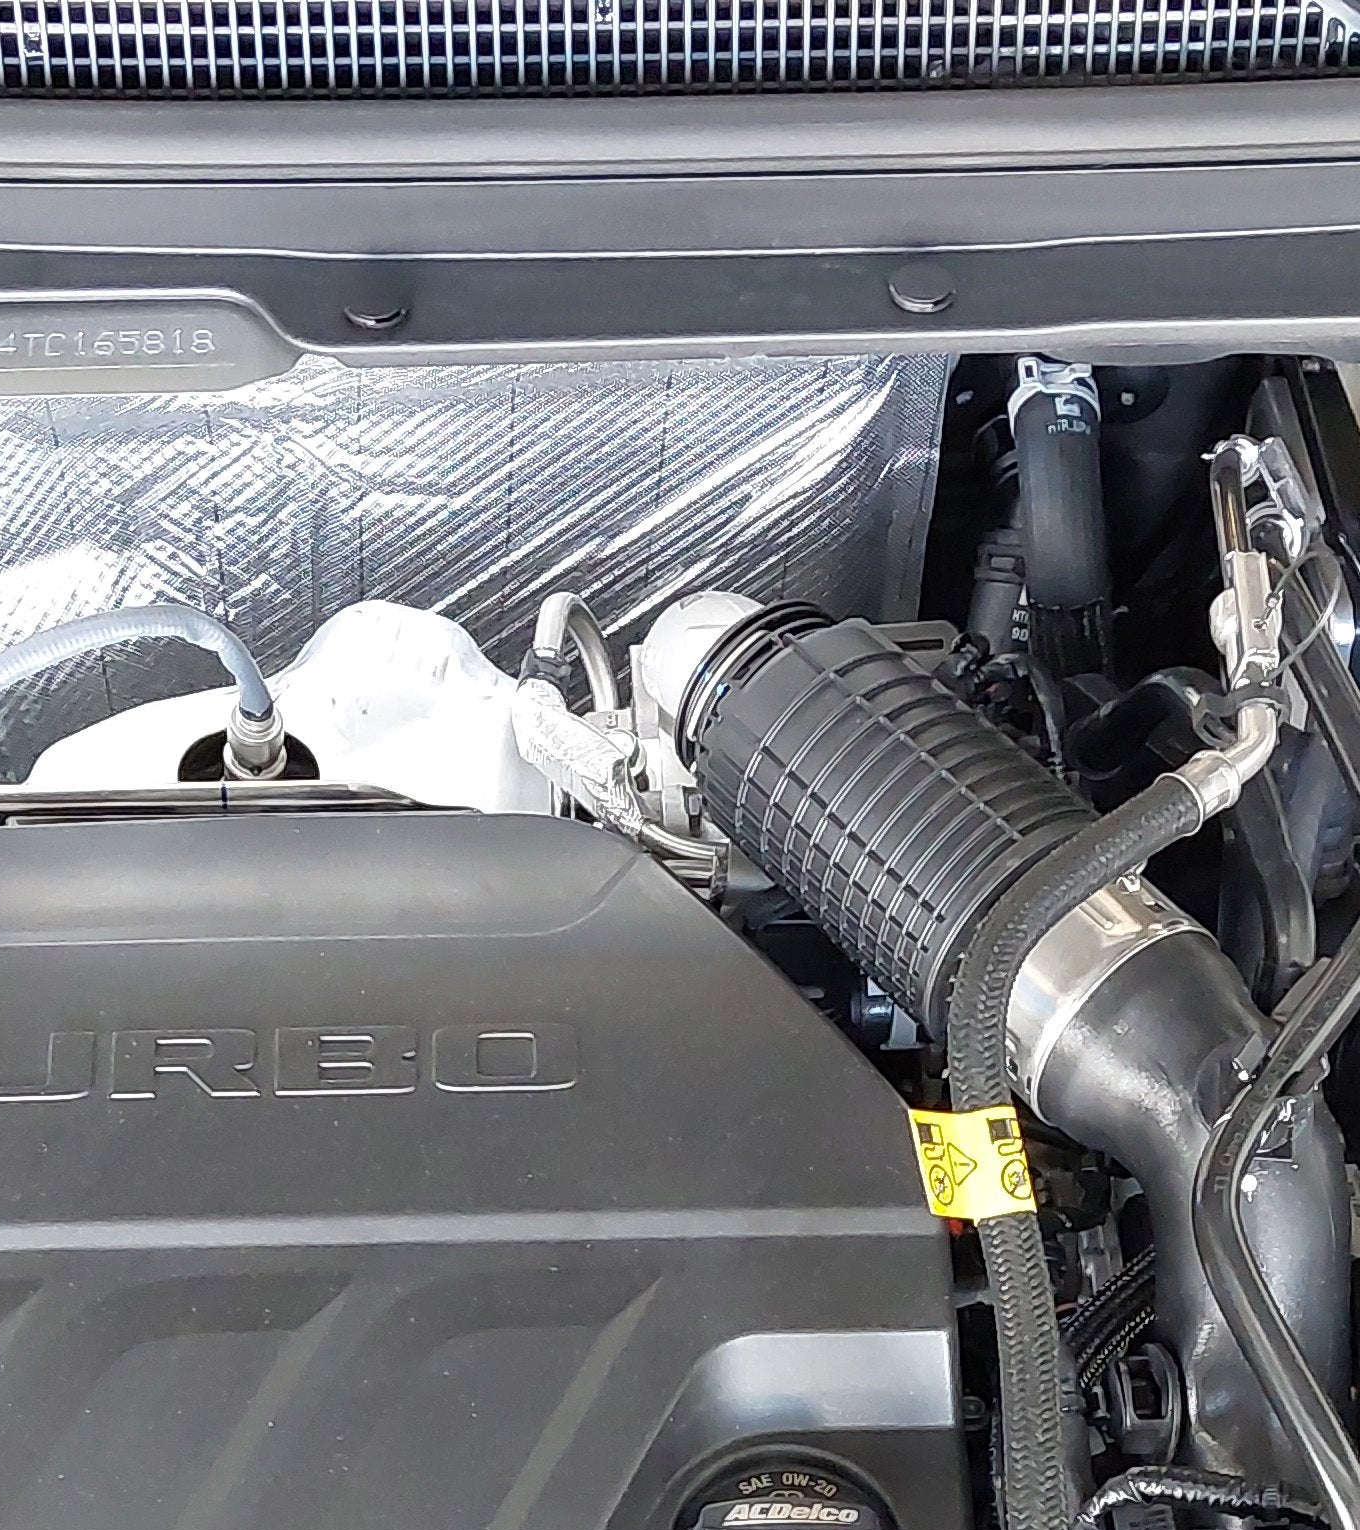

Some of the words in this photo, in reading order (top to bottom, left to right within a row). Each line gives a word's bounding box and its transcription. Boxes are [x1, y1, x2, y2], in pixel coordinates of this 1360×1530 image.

[739, 1473, 774, 1495] SAE
[782, 1473, 838, 1498] 0W-20
[724, 1503, 860, 1523] ACDelco
